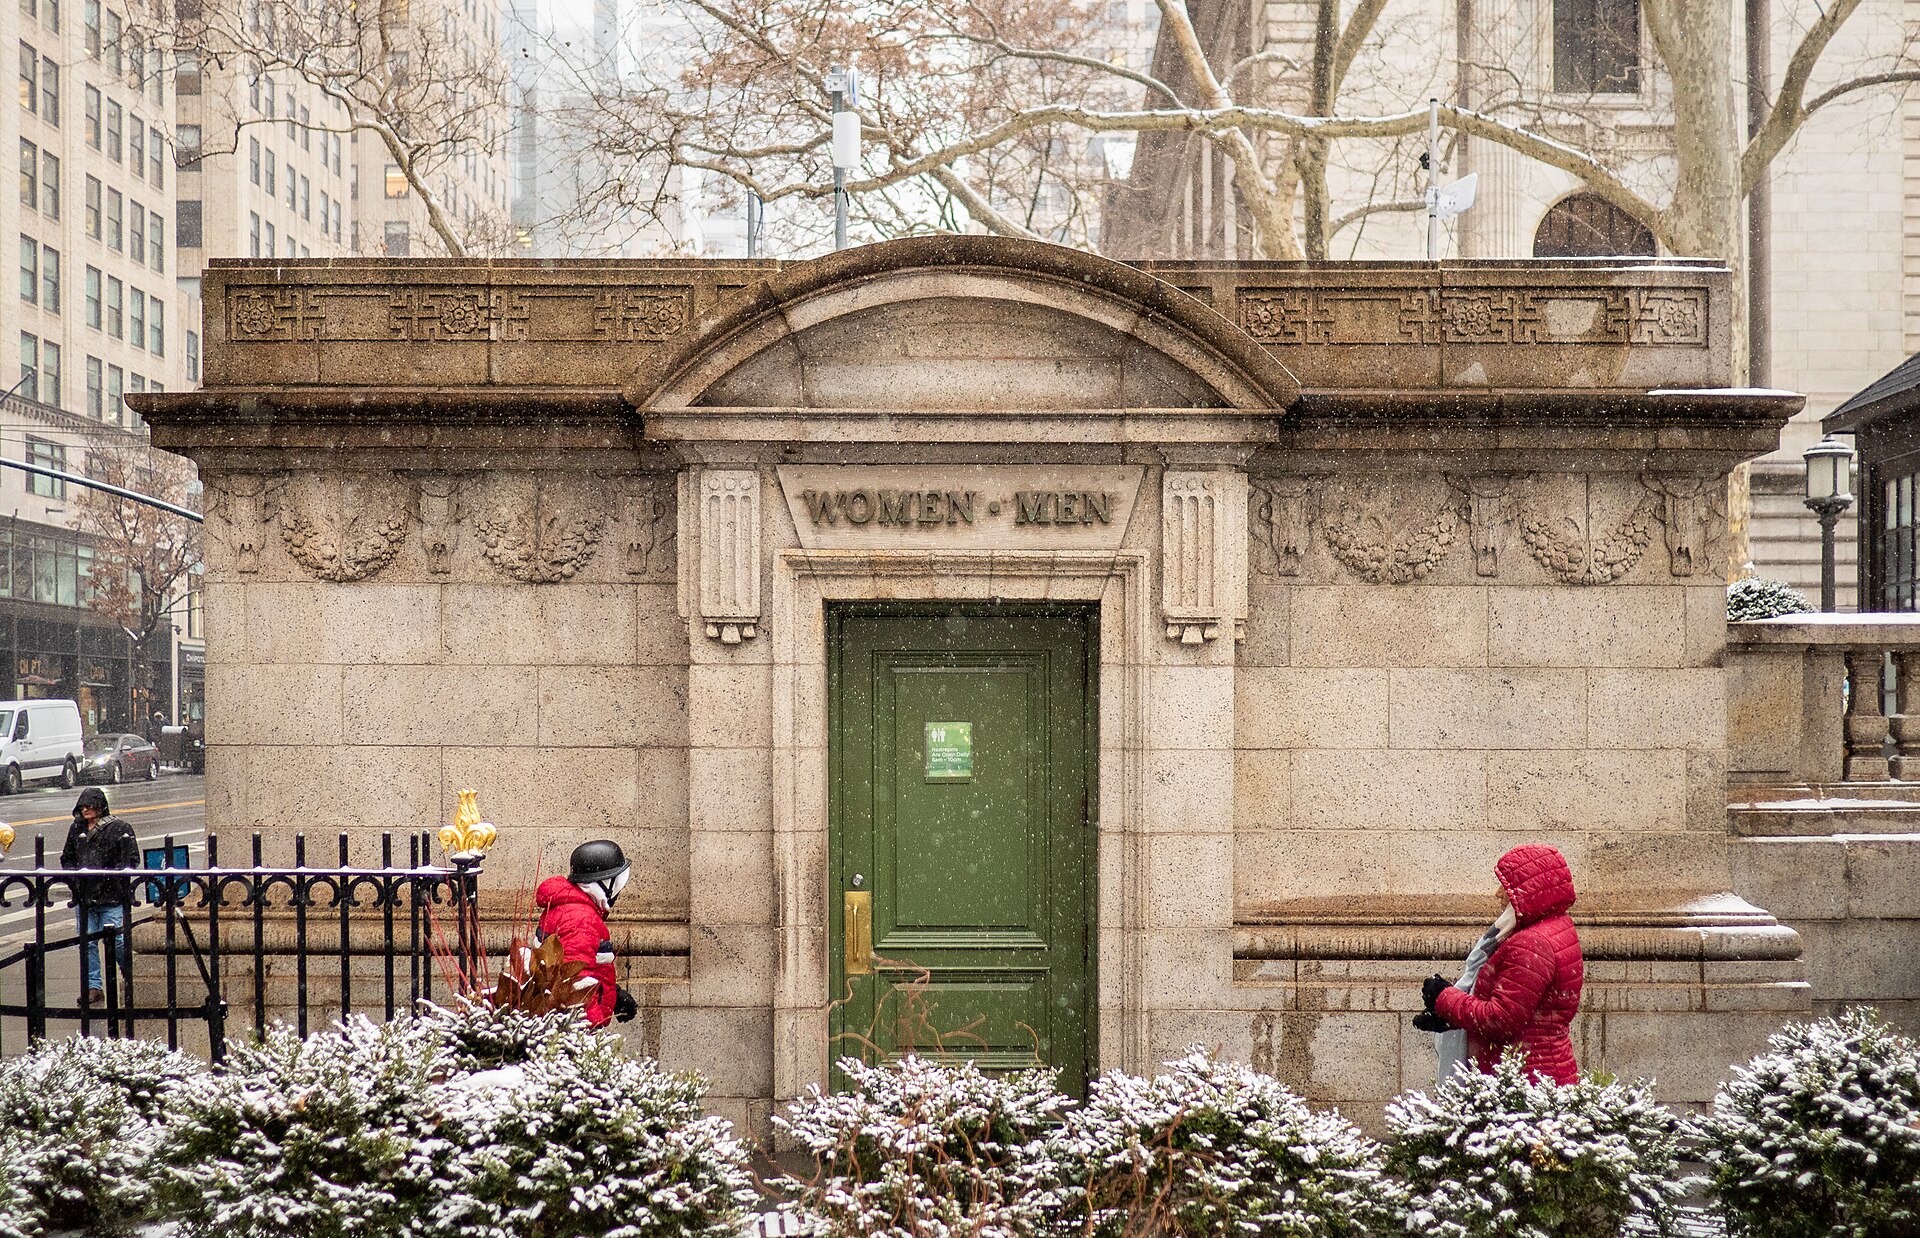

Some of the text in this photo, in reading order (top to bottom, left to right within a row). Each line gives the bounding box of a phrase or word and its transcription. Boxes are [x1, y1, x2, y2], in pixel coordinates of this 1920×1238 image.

[802, 488, 1116, 525] WOMEN MEN
[186, 653, 205, 663] CHIPOTL
